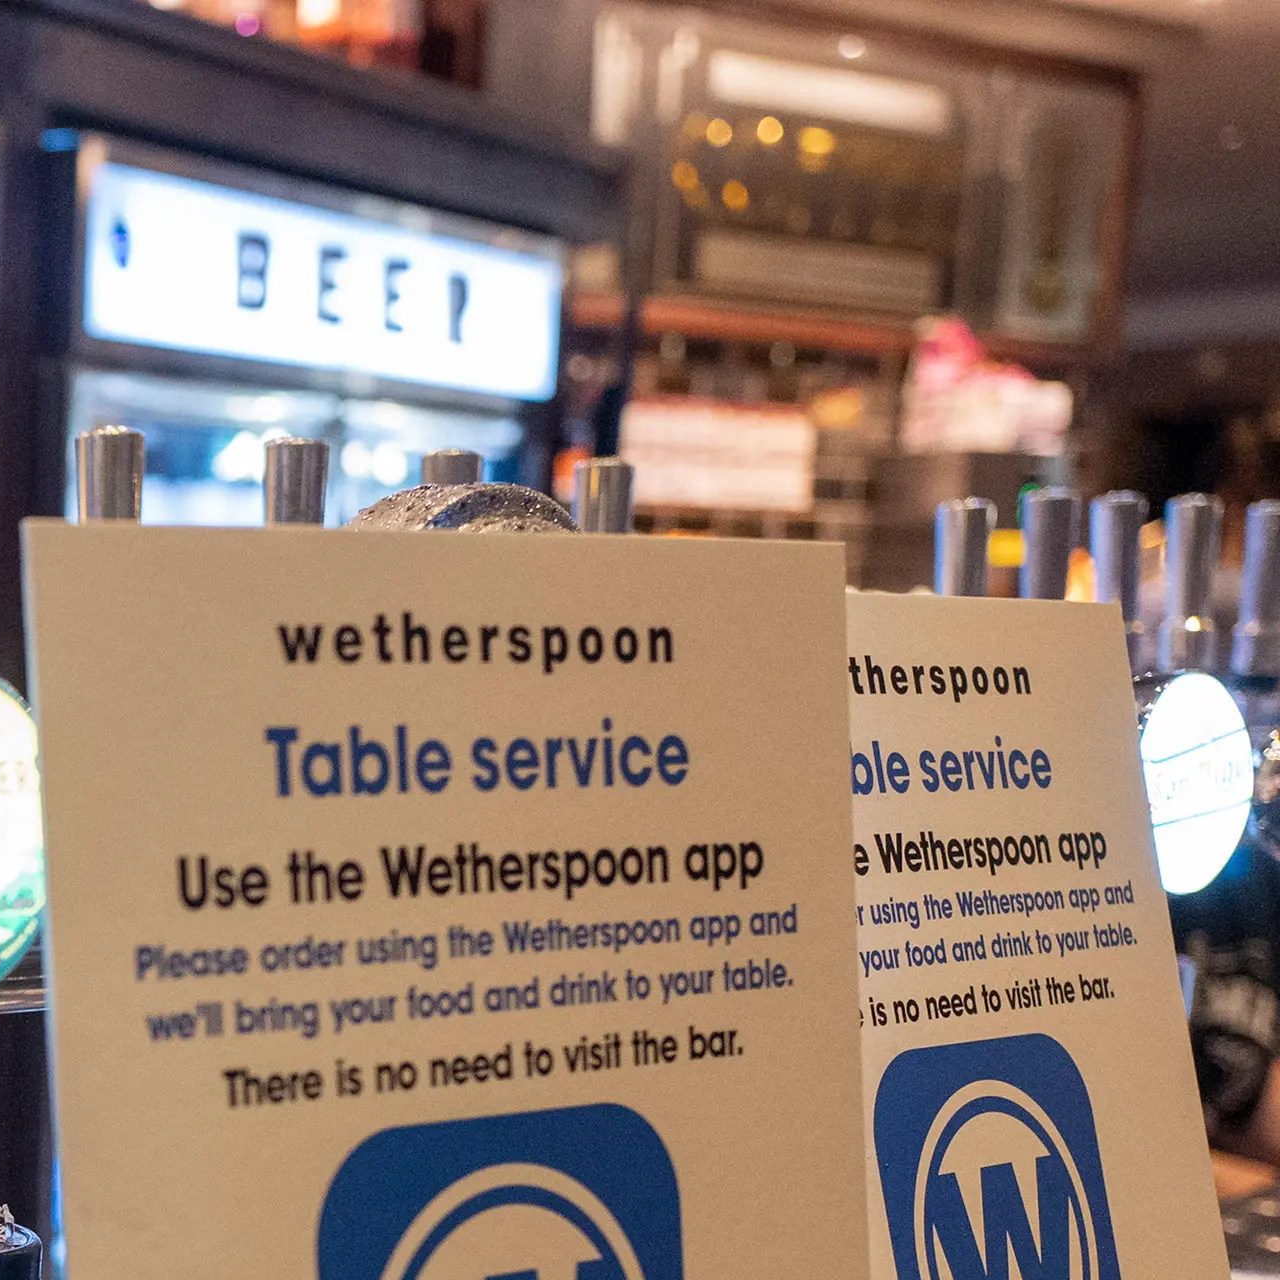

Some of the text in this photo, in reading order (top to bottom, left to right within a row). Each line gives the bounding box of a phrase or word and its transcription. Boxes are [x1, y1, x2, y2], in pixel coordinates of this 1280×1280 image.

[278, 612, 672, 673] wetherspoon
[849, 655, 1030, 702] therspoon
[265, 718, 688, 796] Table service
[178, 841, 763, 909] Use the Wetherspoon app
[874, 831, 1051, 875] Wetherspoon
[1058, 832, 1106, 869] app
[870, 880, 1133, 928] using the Wetherspoon app and
[134, 902, 798, 980] Please order using the Wetherspoon app and
[860, 922, 1136, 977] your food and drink to your table.
[146, 958, 792, 1040] we'll bring your food and drink to your table.
[868, 974, 1114, 1026] is no need to visit the bar.
[223, 1025, 742, 1106] There is no need to visit the bar.
